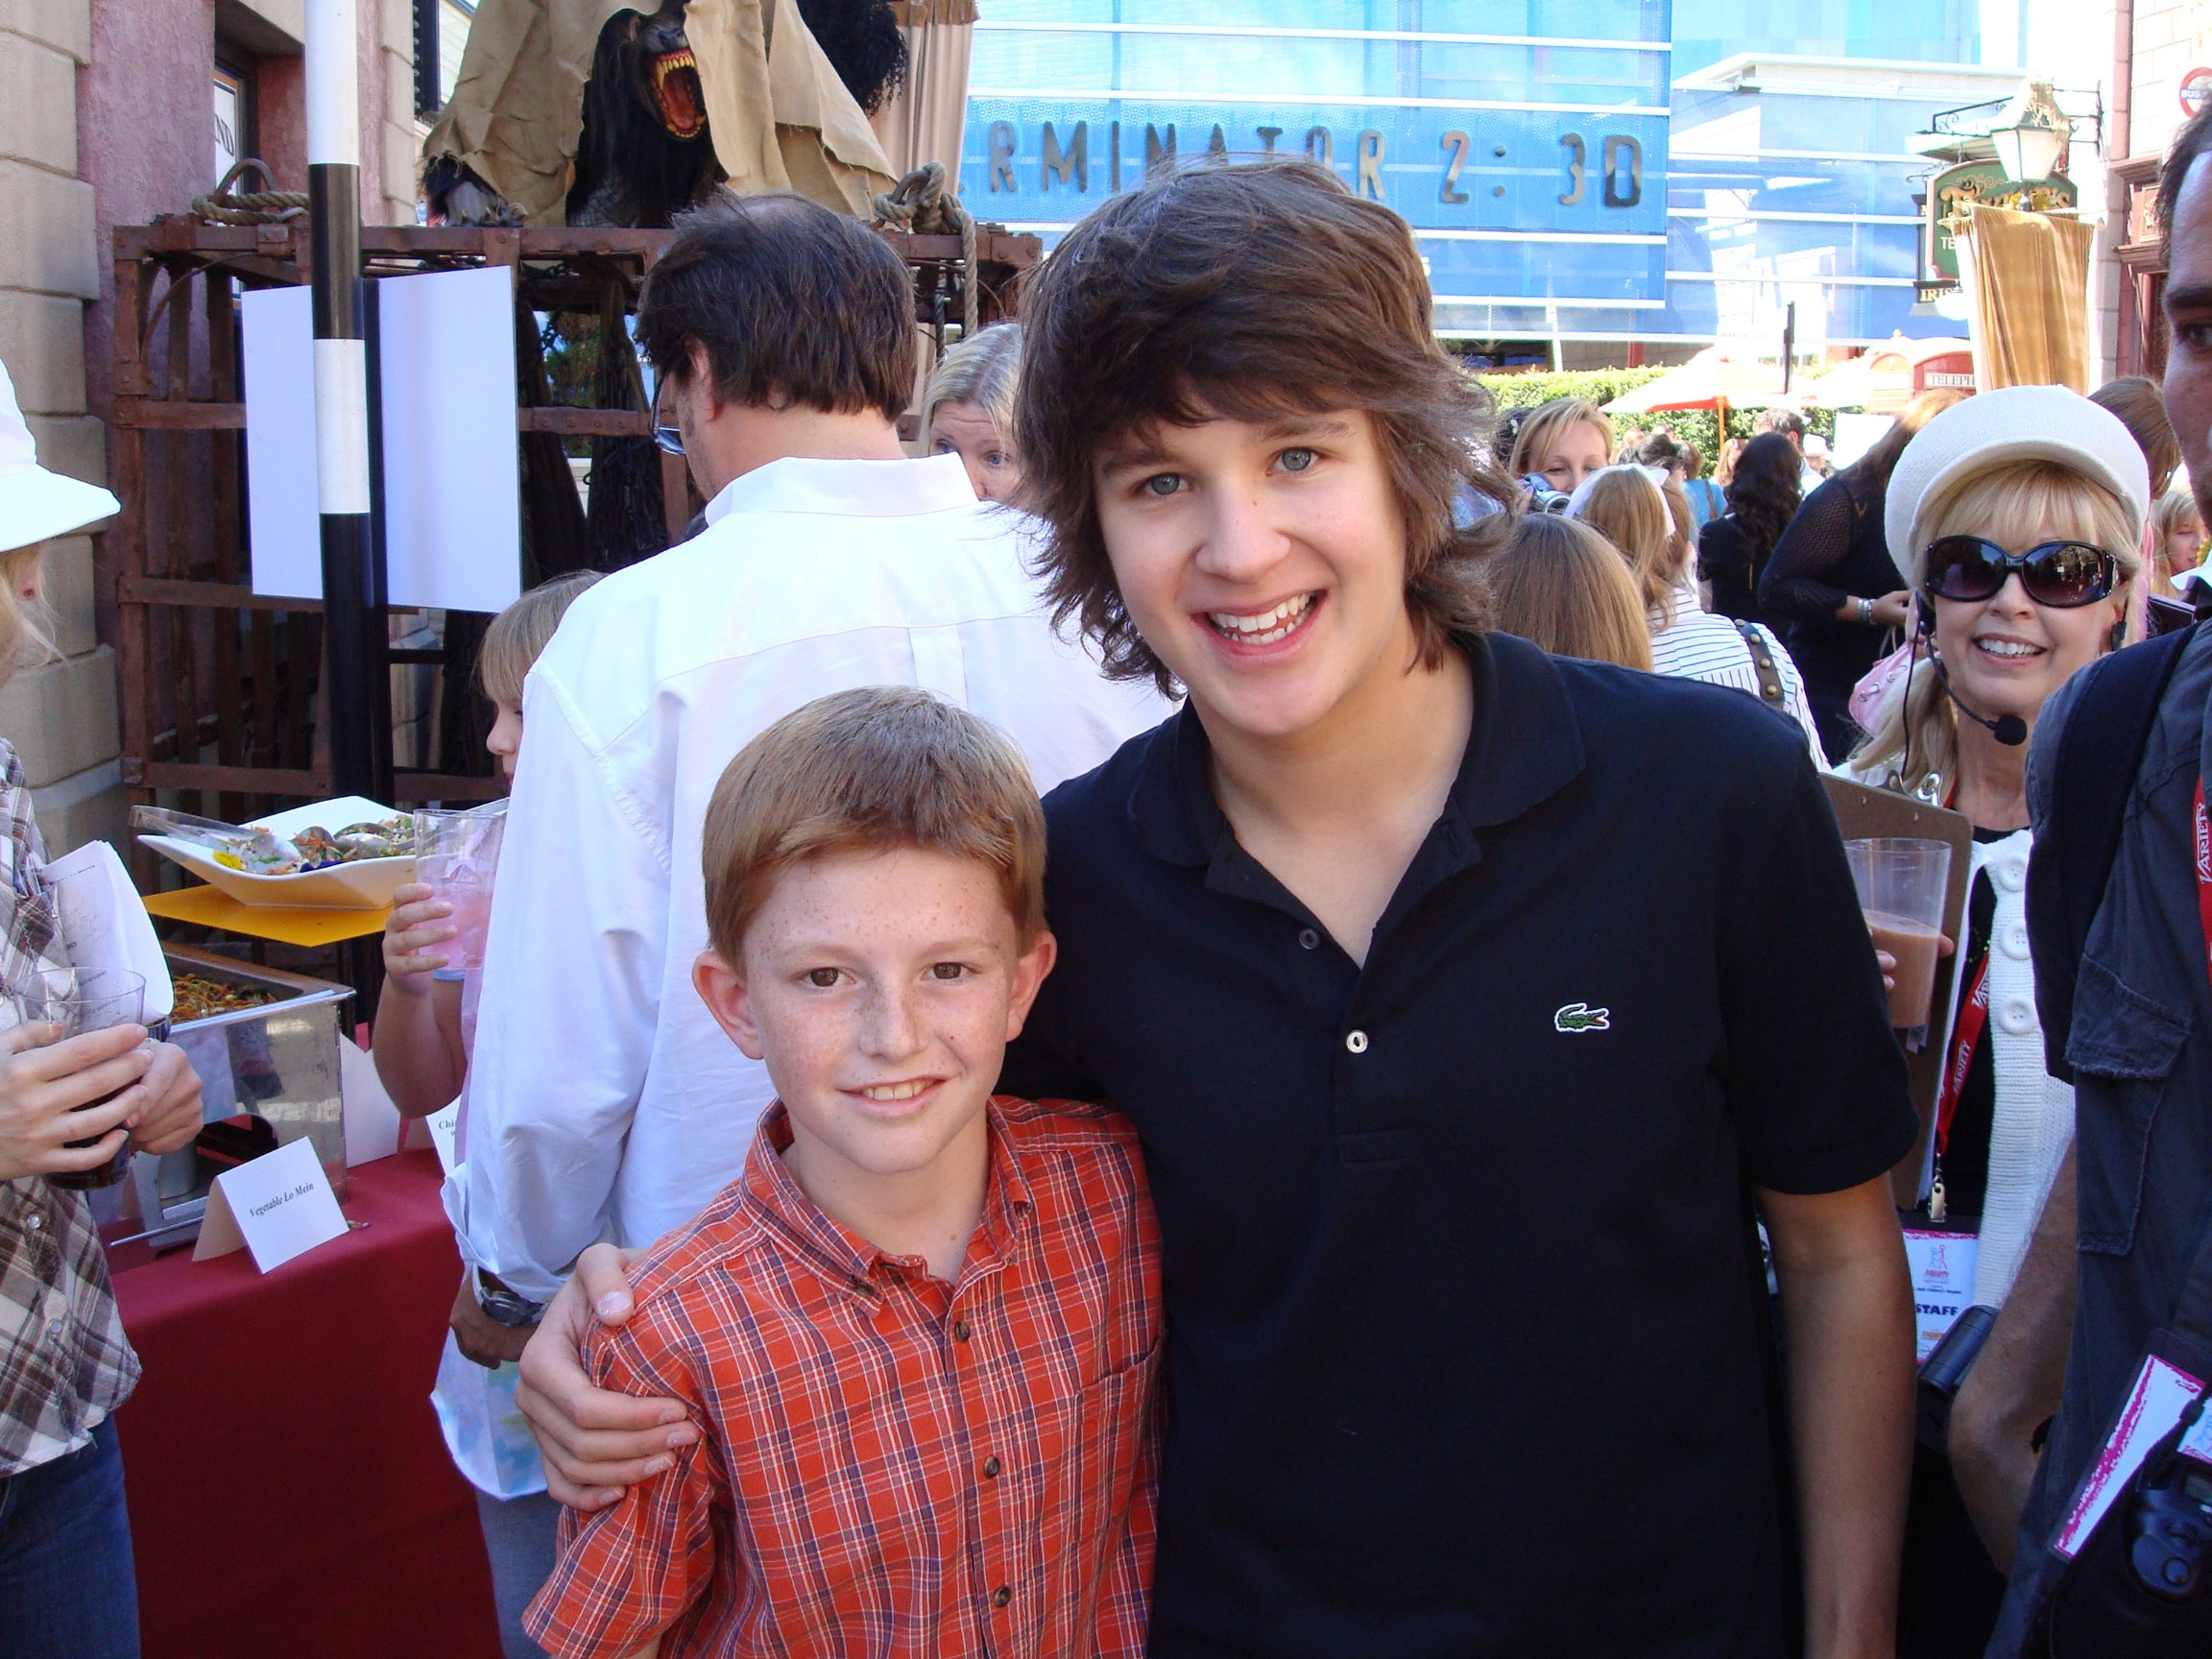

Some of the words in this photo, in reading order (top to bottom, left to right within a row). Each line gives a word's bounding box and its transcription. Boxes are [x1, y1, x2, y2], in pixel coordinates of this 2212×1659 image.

[1559, 132, 1643, 207] 3D
[2196, 802, 2212, 884] VARIETY
[249, 1195, 283, 1216] Vegetable
[283, 1191, 294, 1202] Lo
[295, 1182, 314, 1196] Mein
[1916, 1304, 1959, 1316] STAFF
